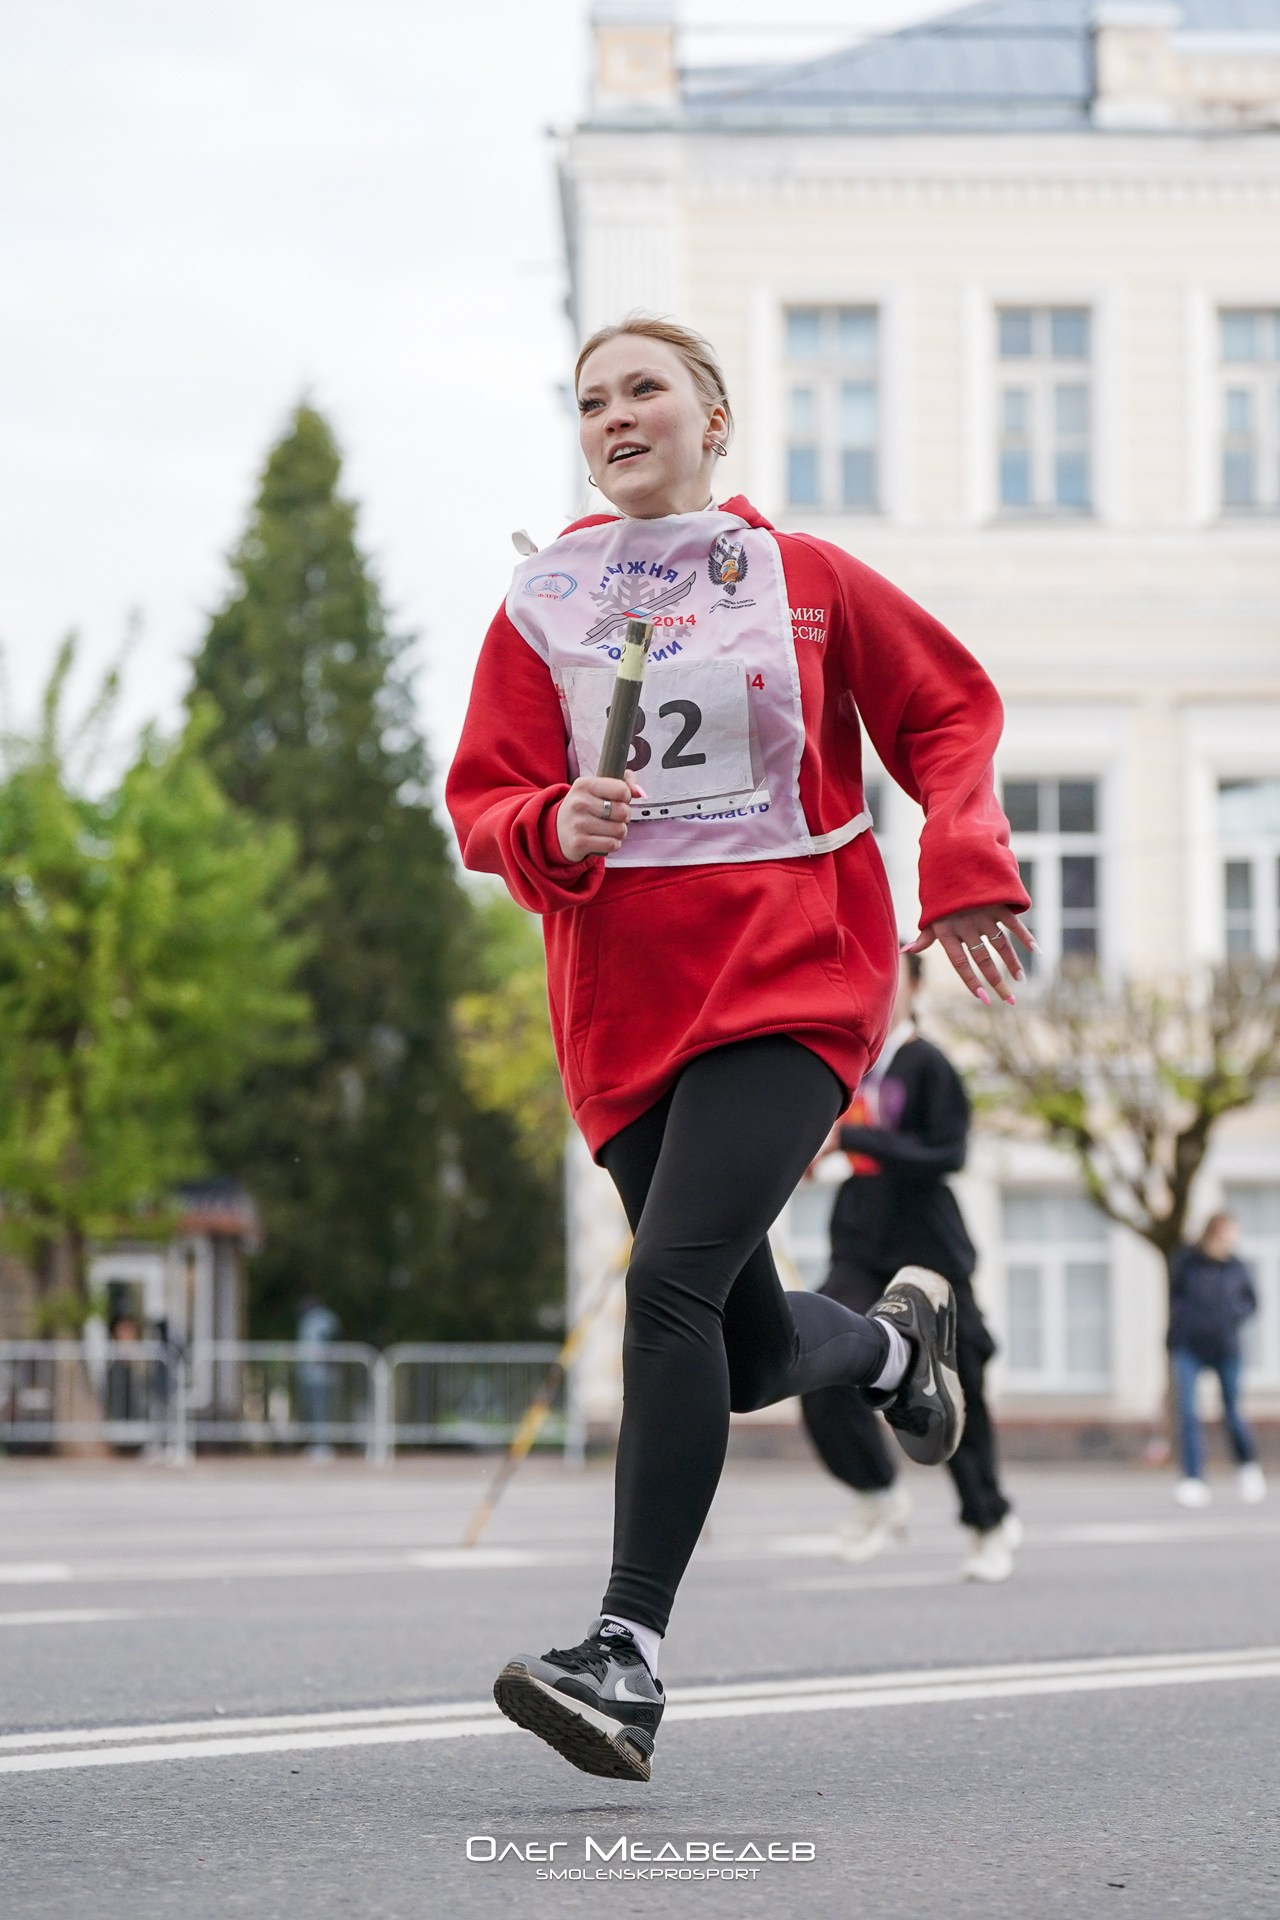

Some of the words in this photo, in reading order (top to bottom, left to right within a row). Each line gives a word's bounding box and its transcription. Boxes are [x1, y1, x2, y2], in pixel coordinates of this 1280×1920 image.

[651, 614, 697, 627] 2014
[596, 640, 683, 663] РОИИ
[605, 1622, 627, 1635] NIKE
